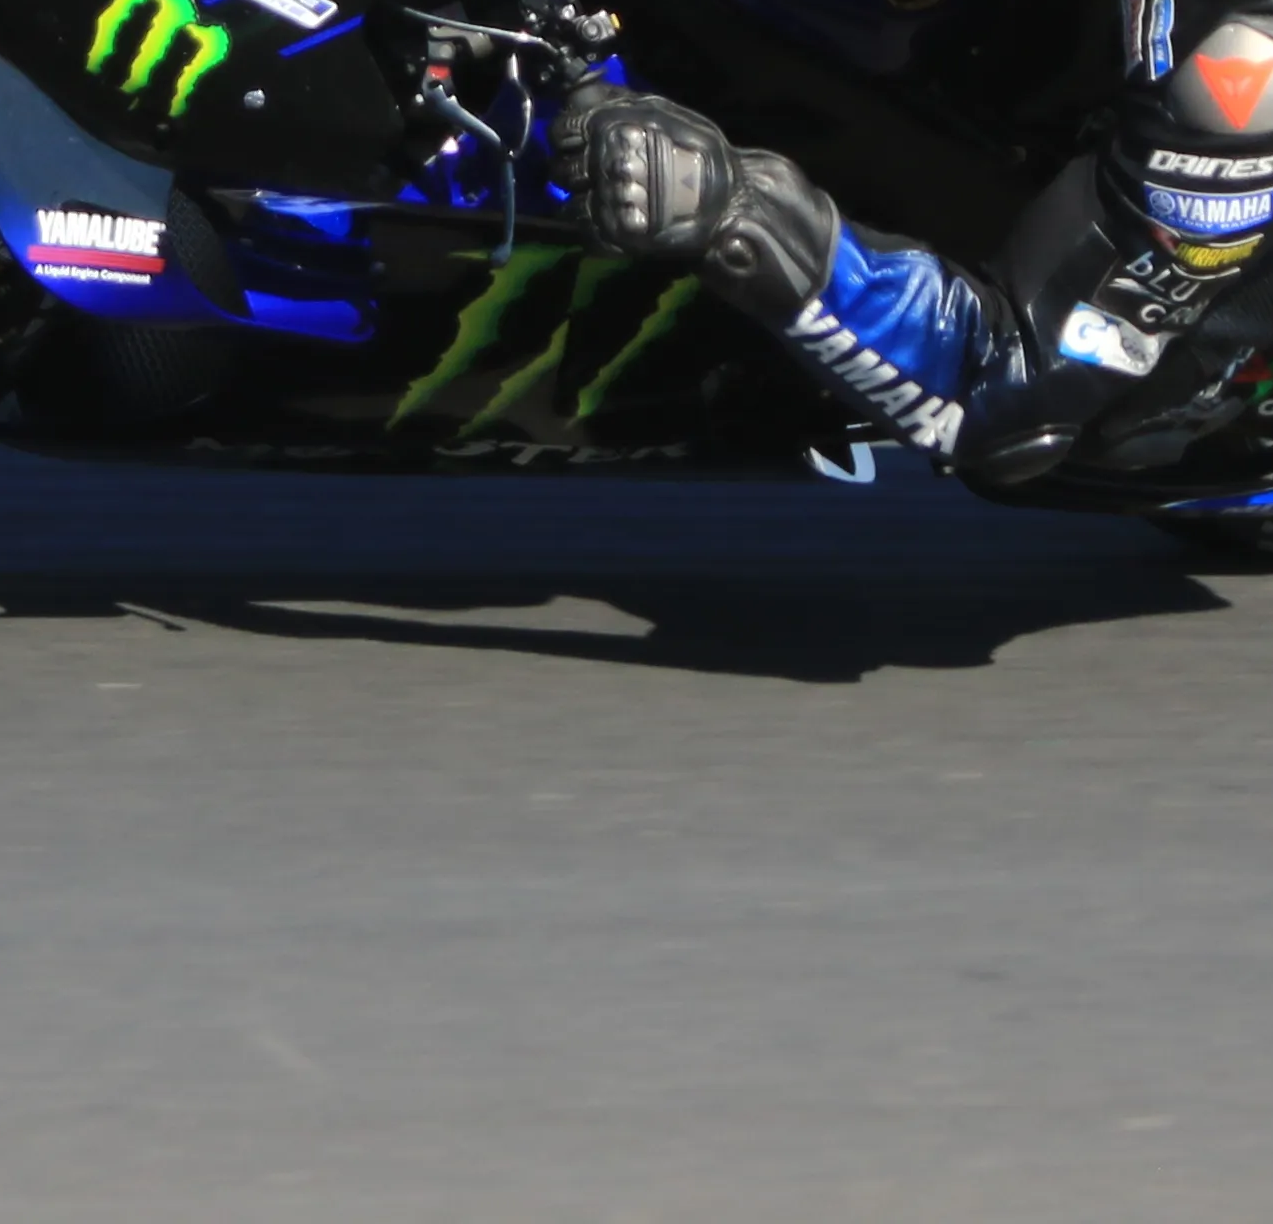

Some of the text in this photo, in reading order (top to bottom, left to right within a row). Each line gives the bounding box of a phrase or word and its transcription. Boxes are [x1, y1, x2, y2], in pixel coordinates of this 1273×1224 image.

[1177, 193, 1273, 223] YAMAHA
[36, 208, 162, 256] YAMALUBE
[35, 264, 45, 276] A
[45, 264, 70, 278] Liquid
[100, 269, 152, 284] Component
[784, 298, 965, 455] YAMAHA
